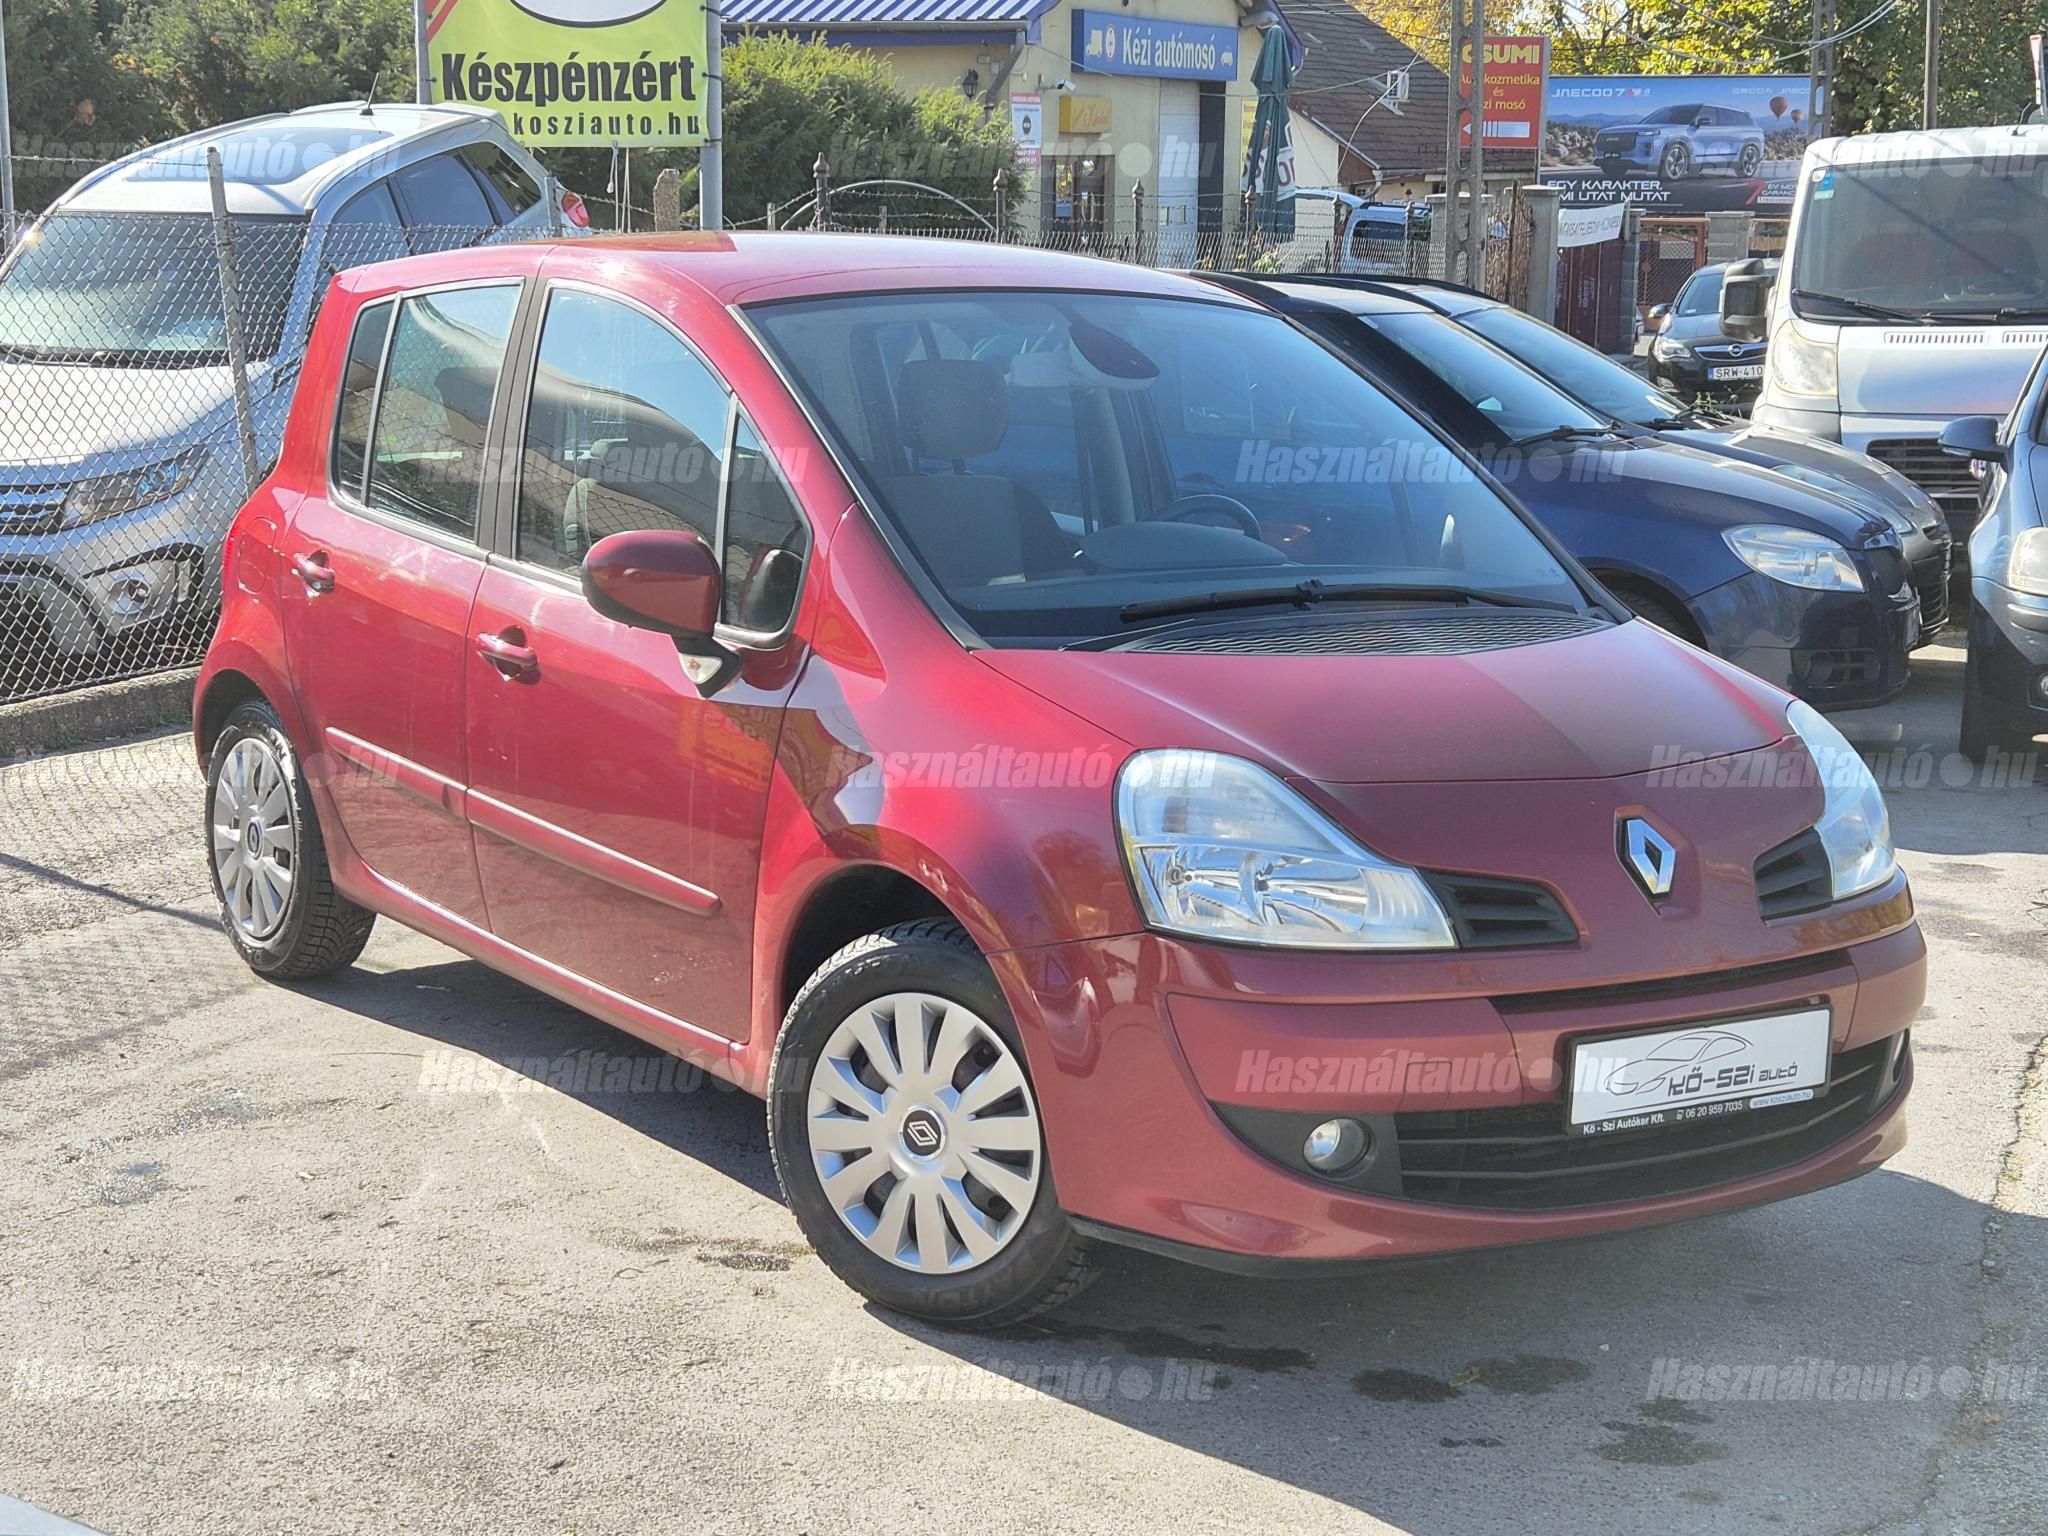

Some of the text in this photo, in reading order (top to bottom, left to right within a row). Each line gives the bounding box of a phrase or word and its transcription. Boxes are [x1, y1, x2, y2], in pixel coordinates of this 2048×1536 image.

[1122, 27, 1216, 70] Kézi autómosó
[442, 51, 696, 107] Készpénzért
[1461, 74, 1540, 85] ukozmetika
[1493, 87, 1504, 97] és
[1495, 99, 1526, 110] mosó
[513, 112, 700, 135] kosziauto.hu
[1620, 191, 1671, 201] MUTAT
[1715, 366, 1763, 378] SRW-410
[1697, 1106, 1707, 1117] 20
[1708, 1104, 1723, 1115] 959
[1724, 1100, 1743, 1112] 7035
